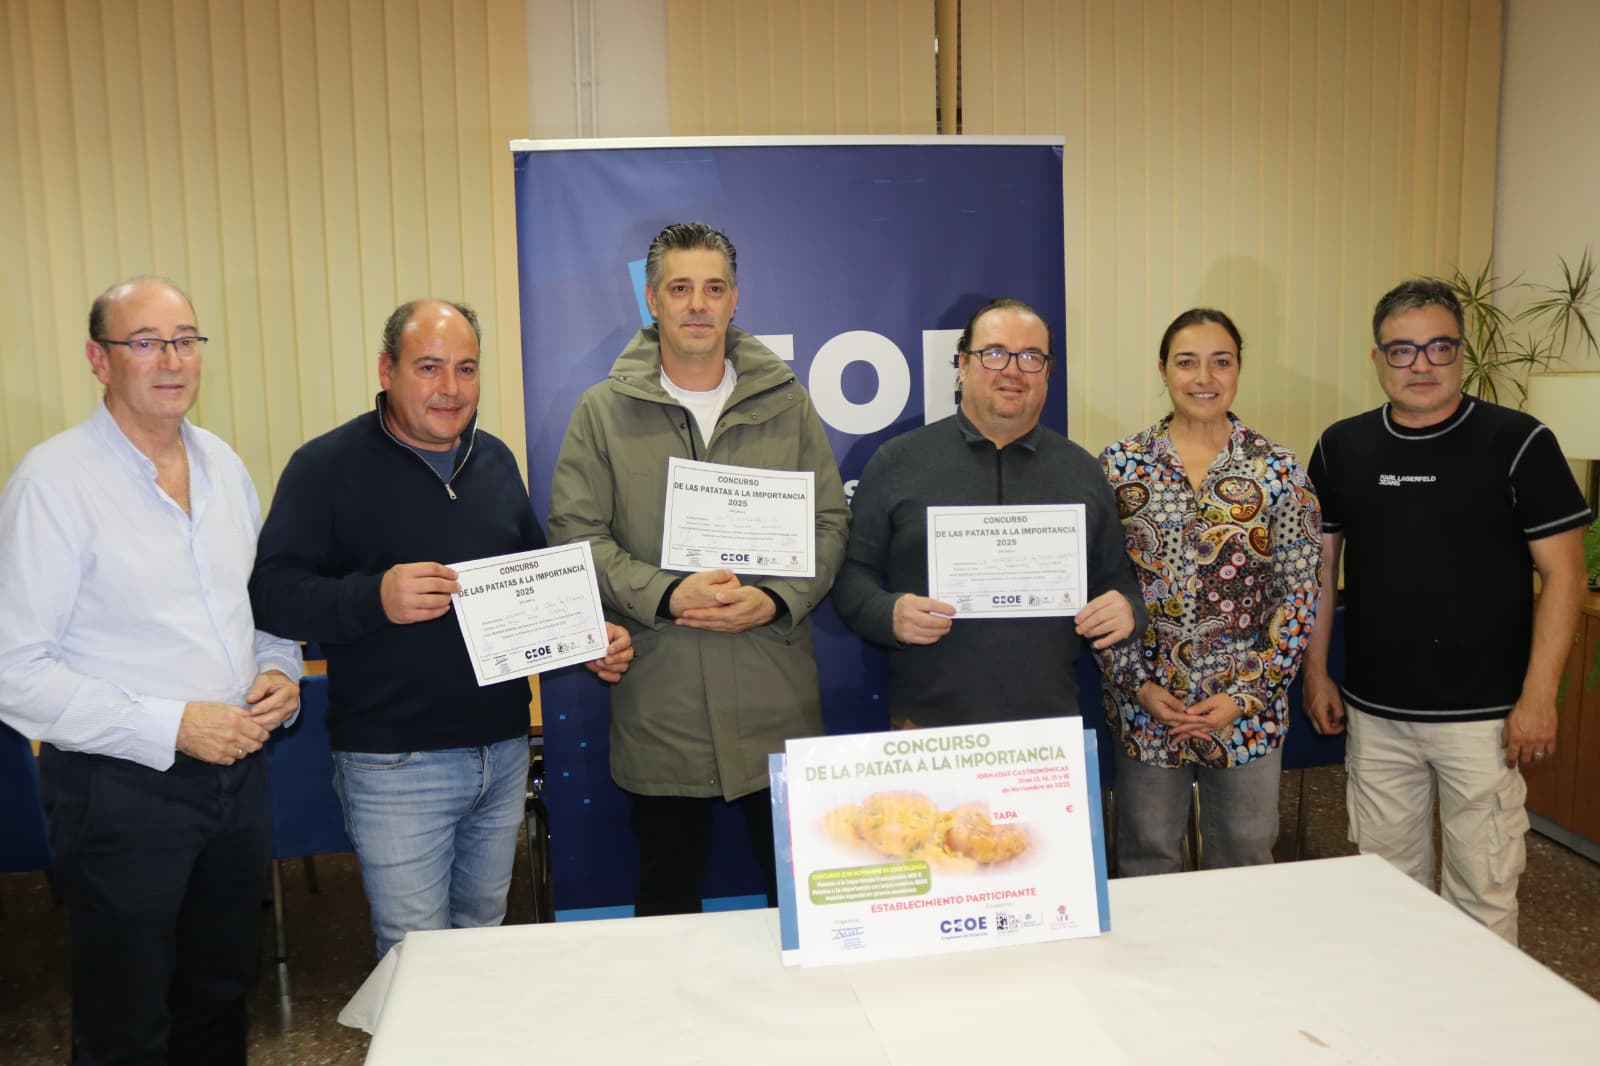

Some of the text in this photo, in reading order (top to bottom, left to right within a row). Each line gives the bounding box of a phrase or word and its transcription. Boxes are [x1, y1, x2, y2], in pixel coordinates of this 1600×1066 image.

[718, 476, 759, 486] CONCURSO
[700, 486, 732, 496] PATATAS
[752, 491, 806, 500] IMPORTANCIA
[984, 516, 1028, 524] CONCURSO
[965, 528, 1000, 537] PATATAS
[1021, 526, 1076, 535] IMPORTANCIA
[720, 553, 750, 562] CEOE
[500, 560, 539, 575] CONCURSO
[459, 589, 470, 598] DE
[470, 586, 485, 596] LAS
[486, 579, 518, 592] PATATAS
[525, 573, 534, 583] LA
[535, 564, 585, 582] IMPORTANCIA
[515, 587, 535, 598] 2025
[992, 595, 1022, 604] CEOE
[525, 645, 552, 660] CEOE
[884, 734, 990, 756] CONCURSO
[806, 746, 1066, 782] DE LA PATATA A LA IMPORTANCIA
[976, 771, 1011, 780] JORNADAS
[994, 811, 1018, 820] TAPA
[871, 888, 1037, 913] ESTABLECIMIENTO PARTICIPANTE
[940, 916, 987, 933] CEOE
